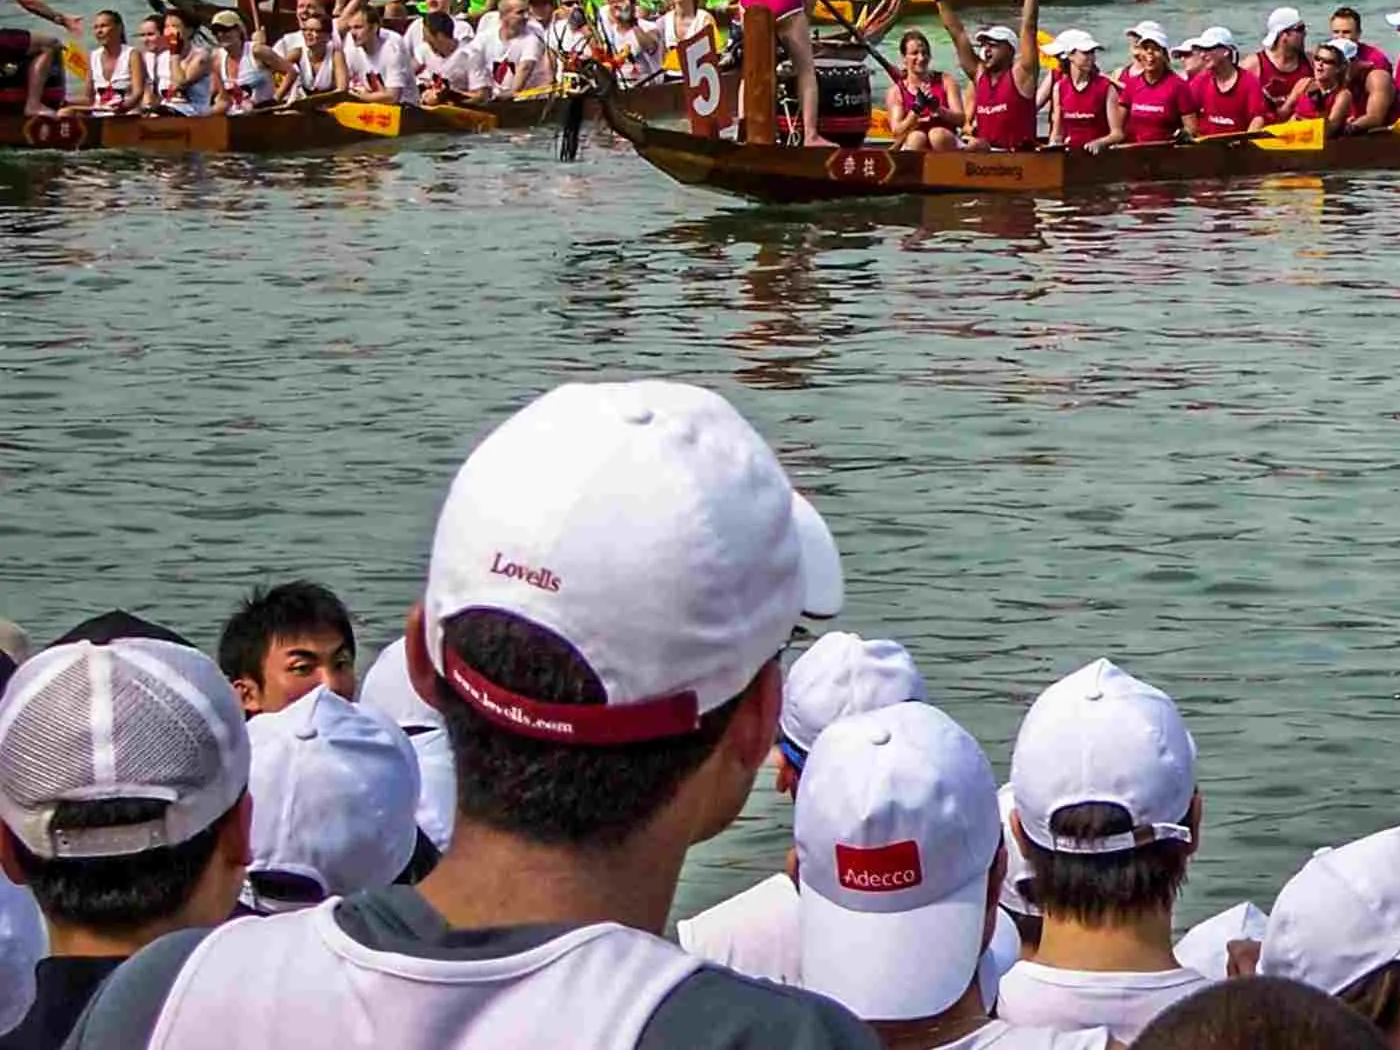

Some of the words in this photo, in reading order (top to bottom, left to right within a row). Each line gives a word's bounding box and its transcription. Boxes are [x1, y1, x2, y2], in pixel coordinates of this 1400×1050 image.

[685, 35, 720, 117] 5
[490, 552, 562, 593] Lovells
[453, 669, 572, 733] www.lovells.com
[843, 868, 916, 887] Adecco
